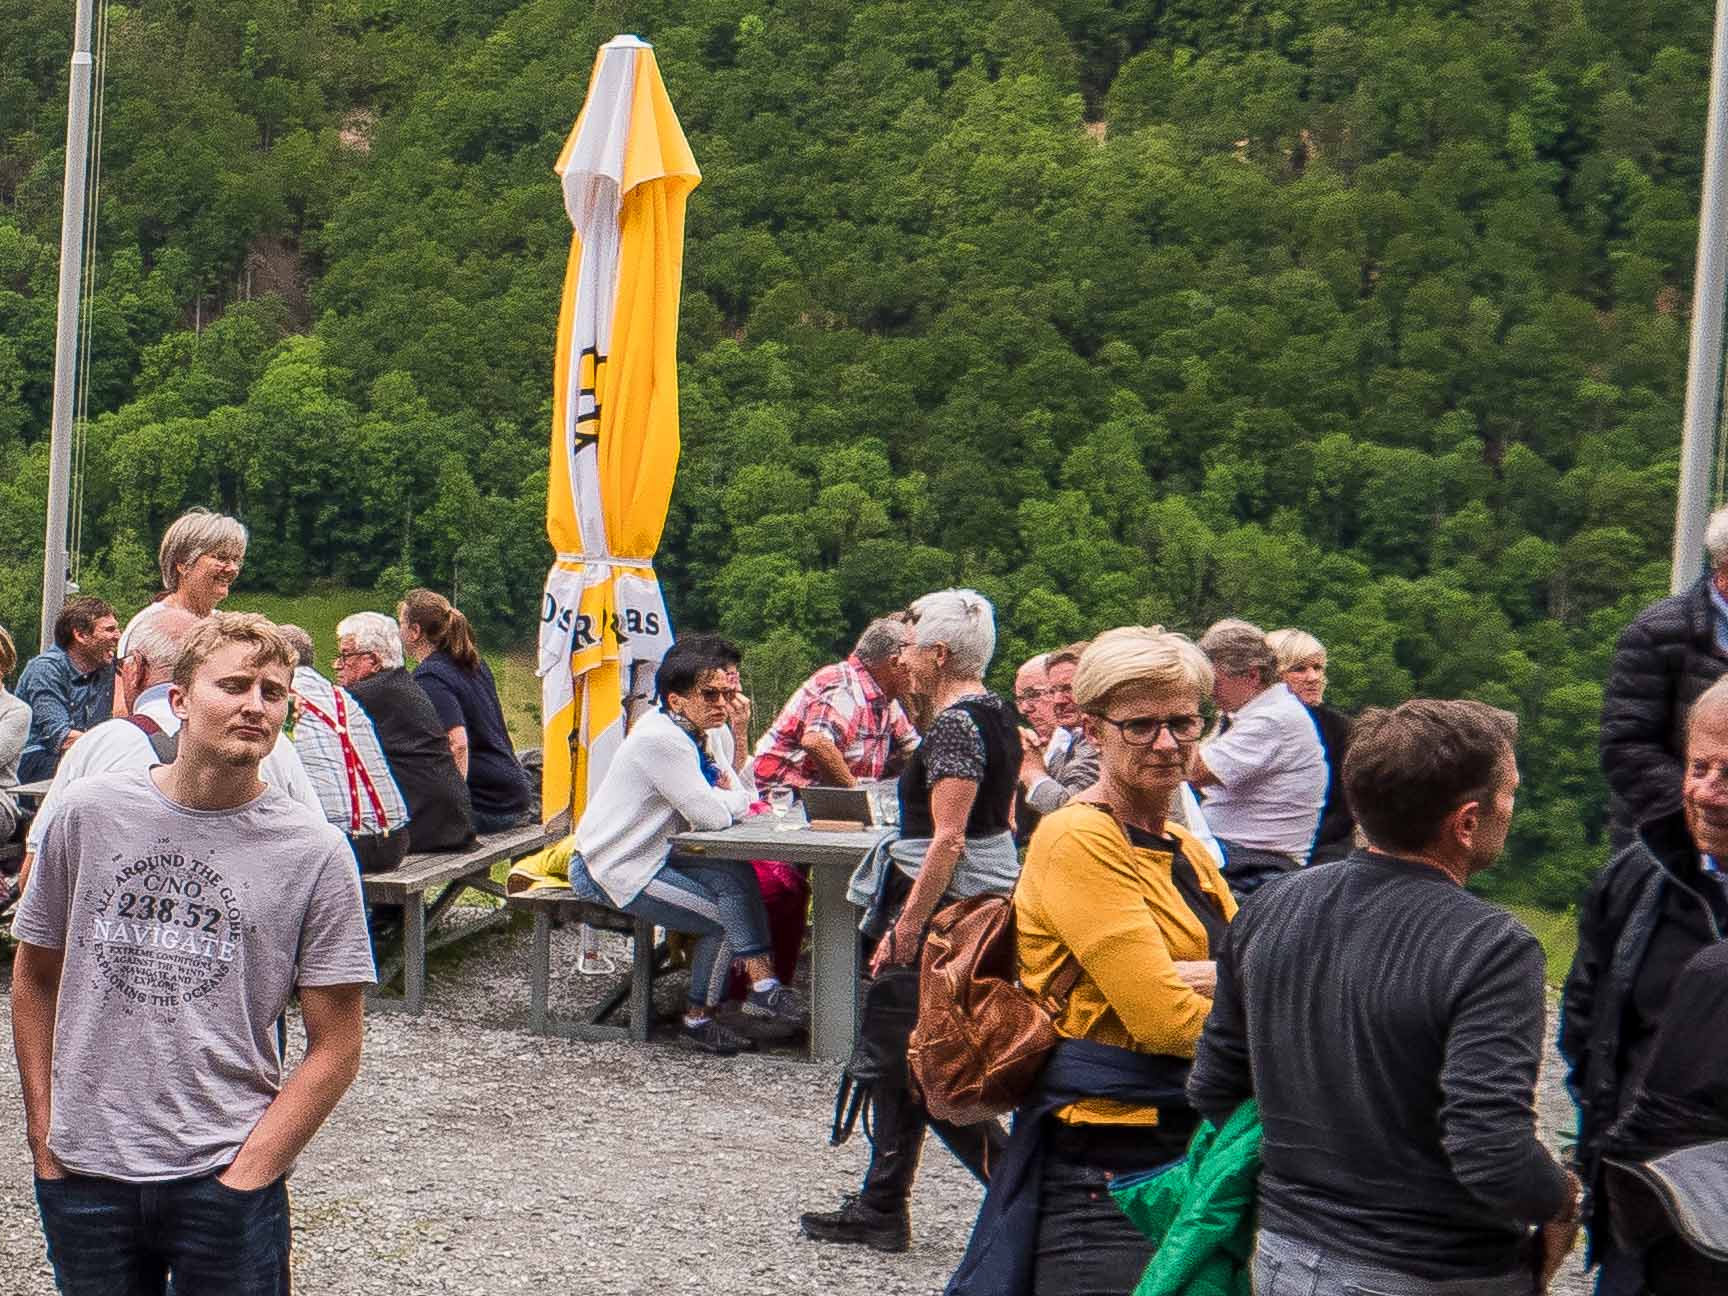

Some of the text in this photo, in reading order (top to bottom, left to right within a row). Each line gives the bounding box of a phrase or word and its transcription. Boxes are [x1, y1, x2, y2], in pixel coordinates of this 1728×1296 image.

[114, 854, 184, 887] AROUND
[191, 859, 223, 888] THE
[220, 887, 241, 942] GLOBE
[144, 874, 206, 901] C/NO.
[118, 892, 222, 934] 238.52
[94, 919, 235, 961] NAVIGATE
[109, 946, 212, 970] EXTREME CONDITIONS
[94, 943, 230, 1006] EXPLORING THE OCEANS
[113, 956, 154, 967] AGAINST
[178, 965, 205, 978] WIND
